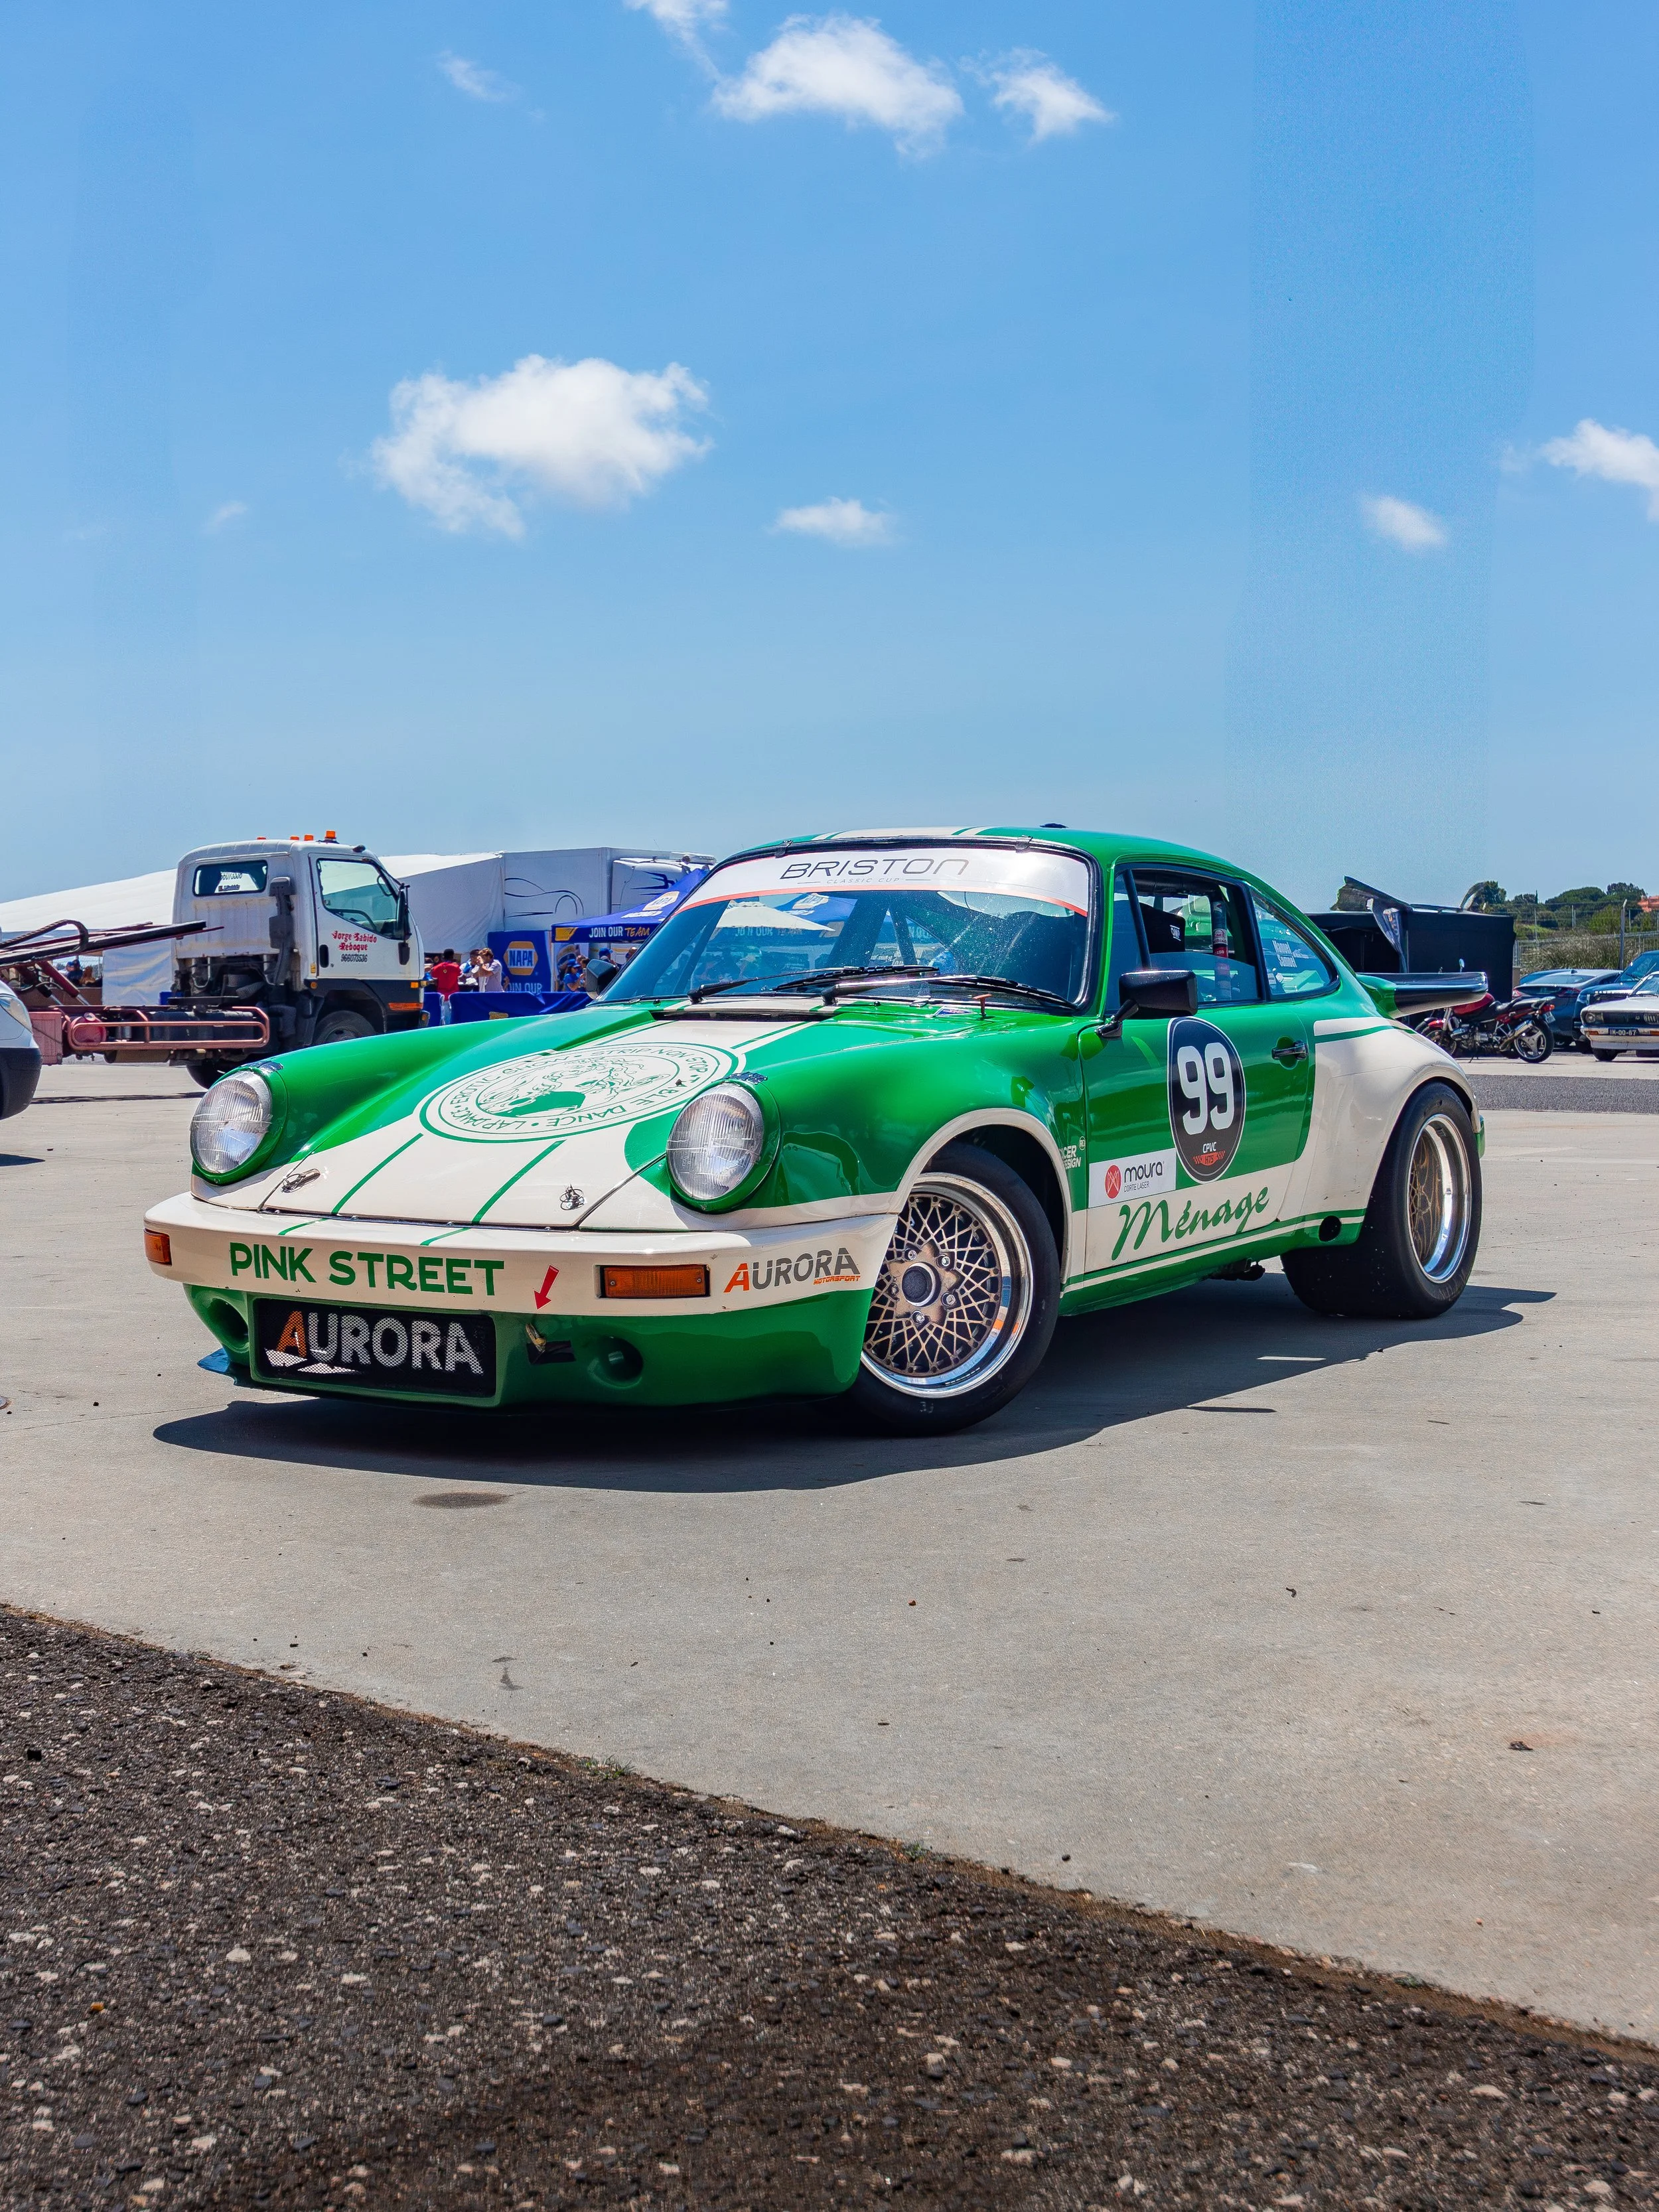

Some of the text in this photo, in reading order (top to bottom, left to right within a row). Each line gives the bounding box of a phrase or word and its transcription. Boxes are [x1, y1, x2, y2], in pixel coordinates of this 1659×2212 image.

[780, 859, 970, 879] BRISTON
[332, 930, 352, 942] Jorge
[589, 926, 650, 938] JOIN OUR TEAM
[338, 942, 368, 952] Reboque
[509, 950, 533, 966] NAPA
[507, 982, 542, 994] OIN OUR
[590, 1048, 709, 1073] STRIP NON STOP
[450, 1075, 502, 1104] EROTIC
[1177, 1042, 1235, 1136] 99
[545, 1104, 627, 1127] DANCE
[1202, 1142, 1217, 1153] CPVC
[1124, 1161, 1163, 1183] moura
[1123, 1181, 1150, 1193] CORTE LASER
[1112, 1187, 1269, 1260] Ménage
[230, 1242, 504, 1296] PINK STREET
[723, 1248, 861, 1293] AURORA
[813, 1275, 861, 1286] MOTORSPORT
[275, 1311, 483, 1376] AURORA
